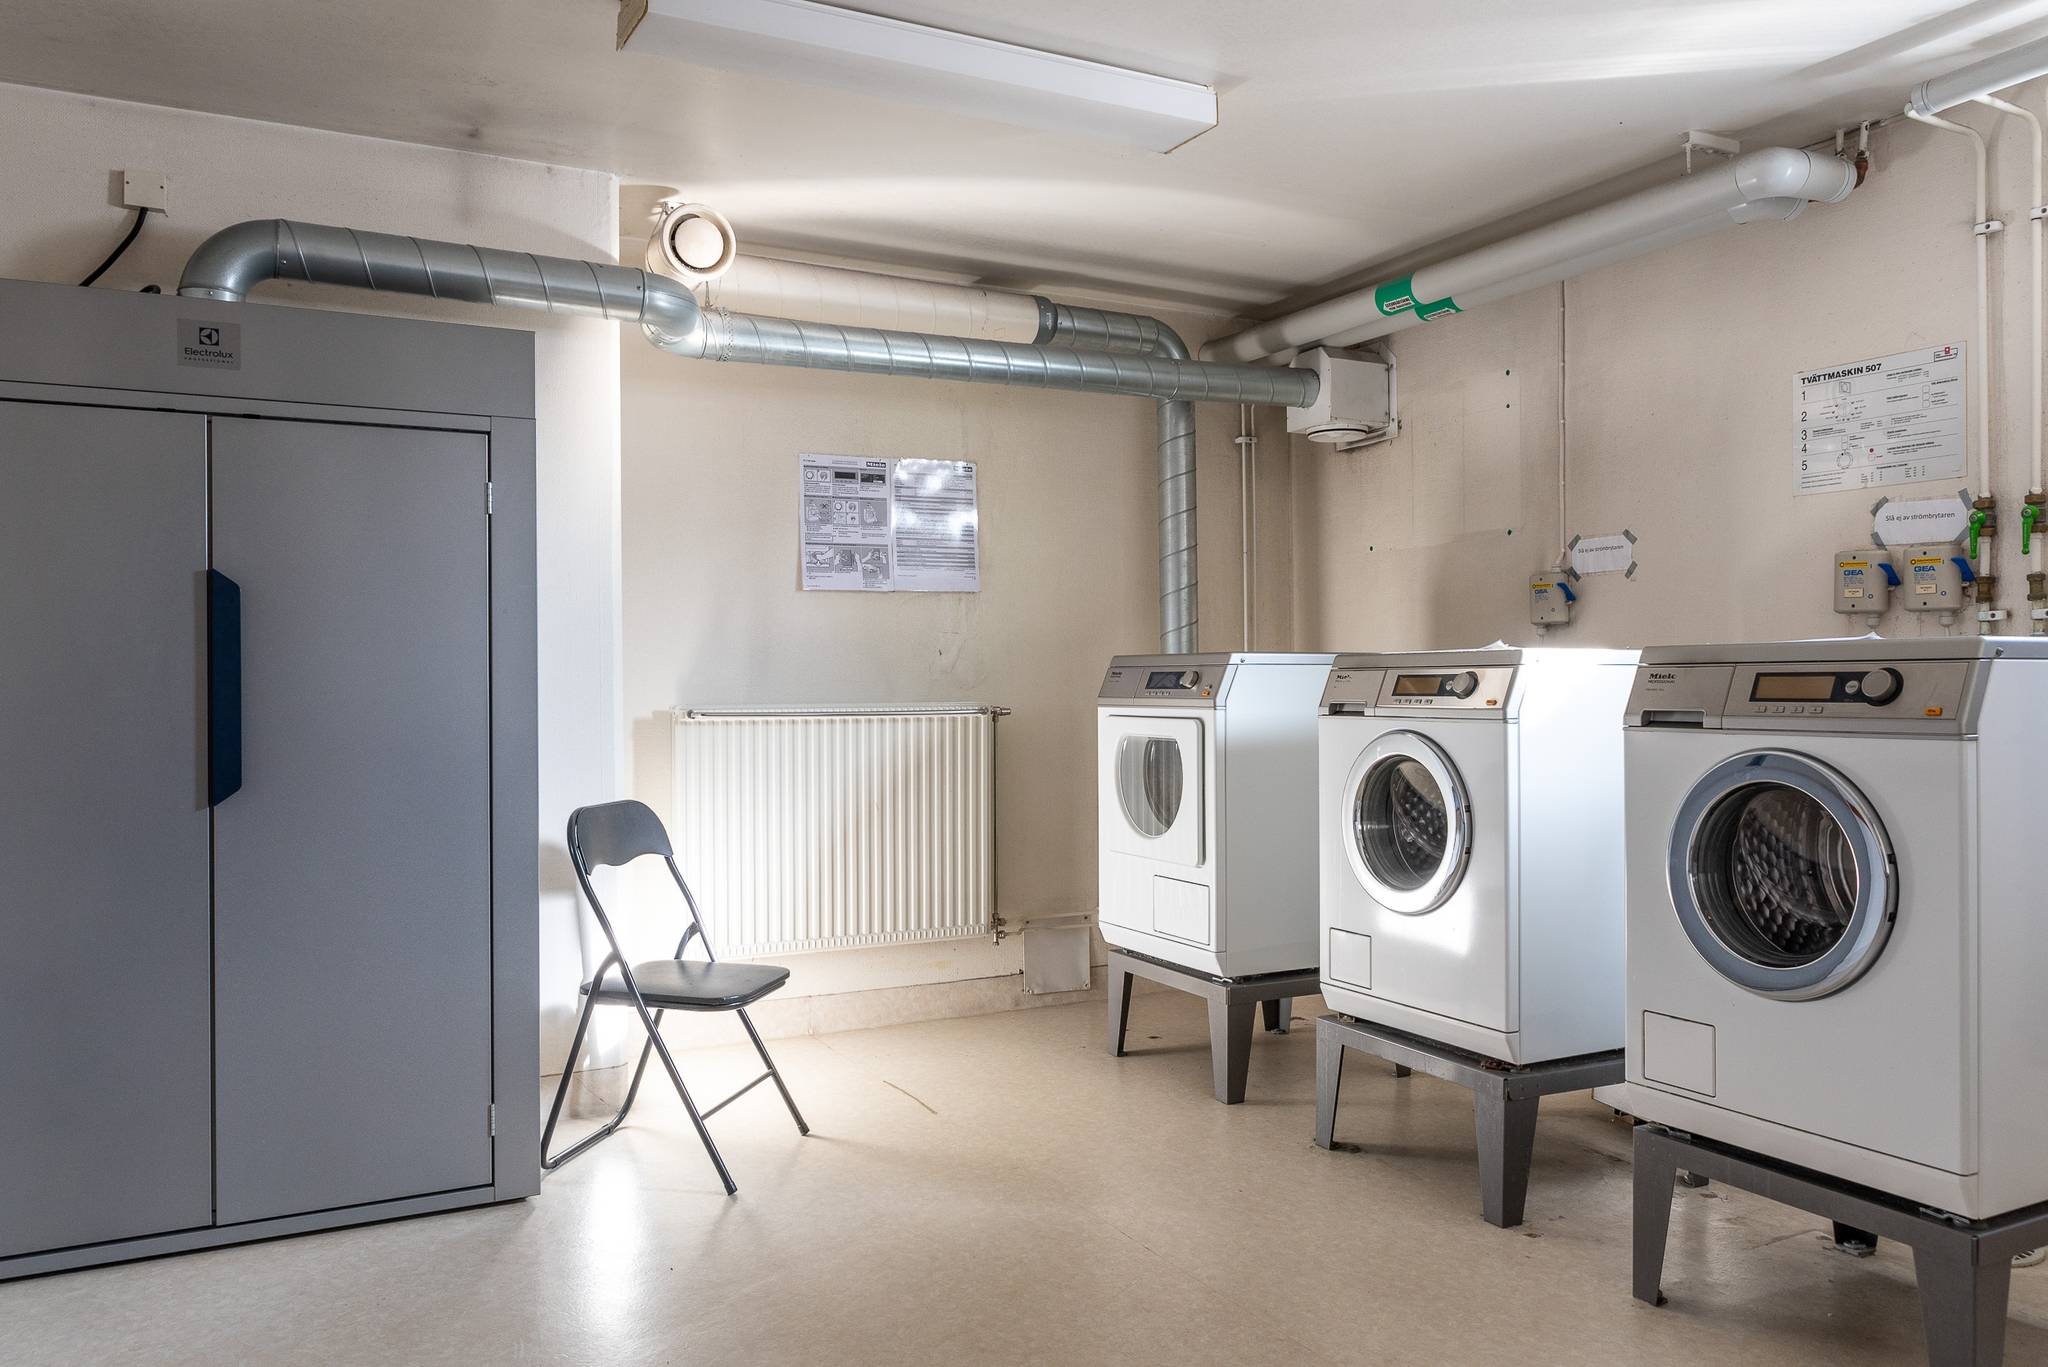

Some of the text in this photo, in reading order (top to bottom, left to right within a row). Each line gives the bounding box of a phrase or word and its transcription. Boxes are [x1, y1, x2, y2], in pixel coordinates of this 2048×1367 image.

[184, 347, 233, 359] Electrolux
[1800, 363, 1882, 385] TVÄTTMASKIN 507
[1801, 390, 1806, 401] 1
[1801, 411, 1807, 422] 2
[1801, 429, 1808, 441] 3
[1801, 443, 1807, 454] 4
[1801, 460, 1808, 471] 5
[1911, 512, 1956, 520] strömbrytaren
[1648, 672, 1678, 680] Miele
